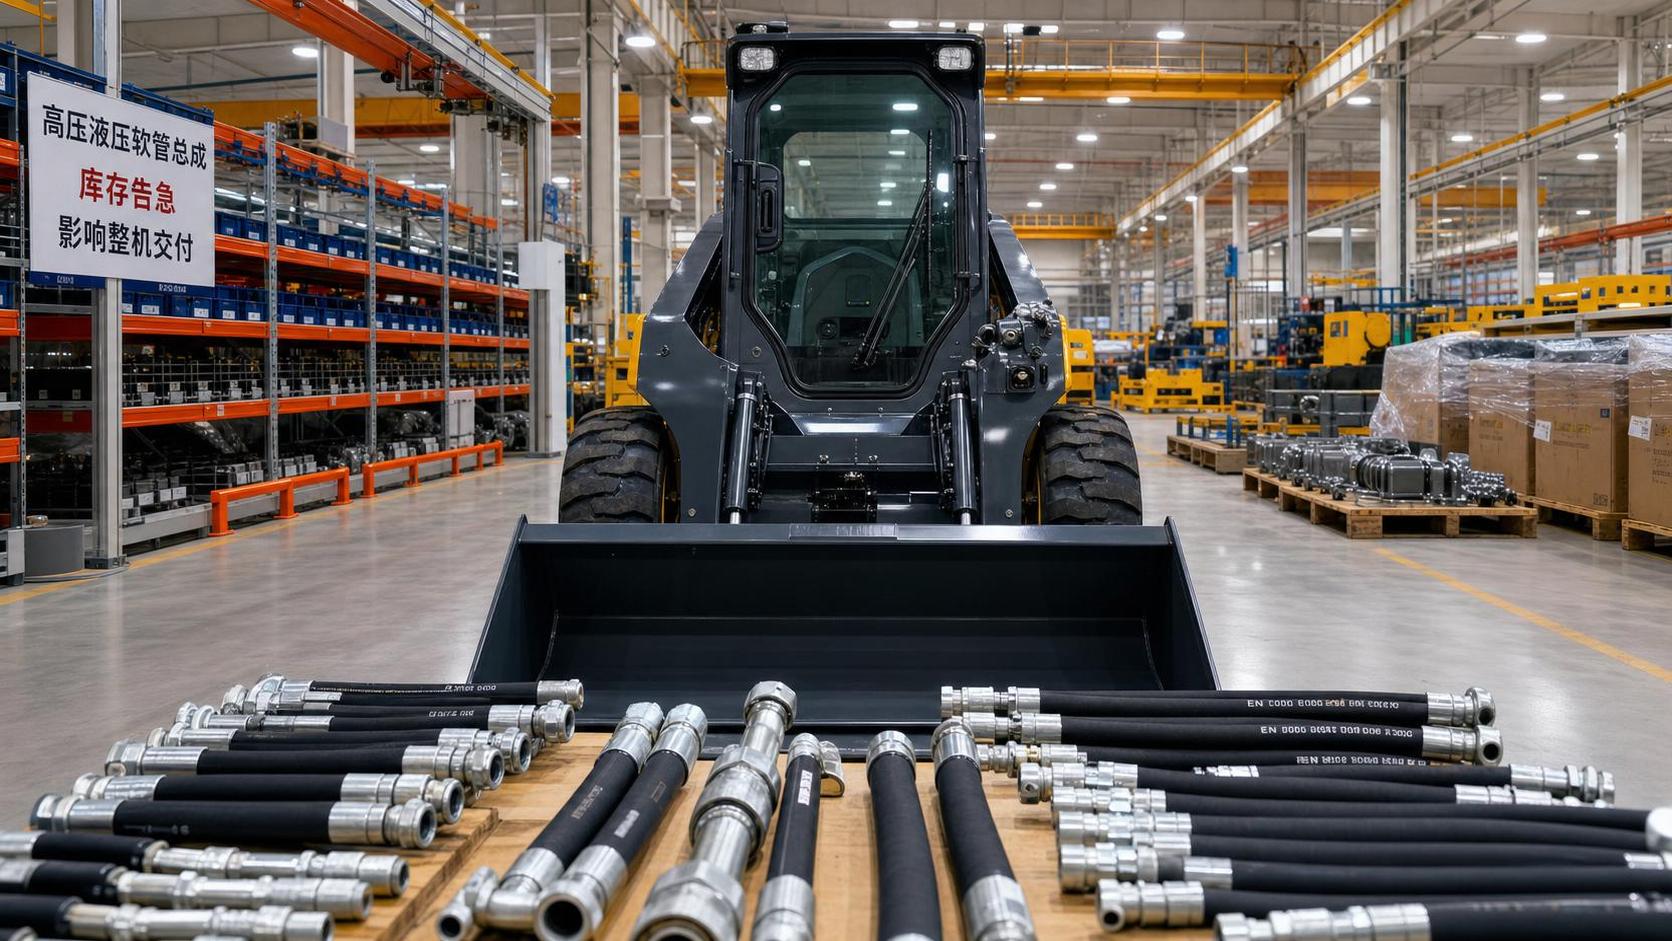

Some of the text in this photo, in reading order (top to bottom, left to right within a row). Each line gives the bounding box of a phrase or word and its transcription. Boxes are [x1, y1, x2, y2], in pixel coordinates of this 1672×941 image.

[42, 103, 207, 170] 高压液压软管总成
[79, 167, 176, 215] 库存告急
[58, 214, 194, 263] 影响整机交付
